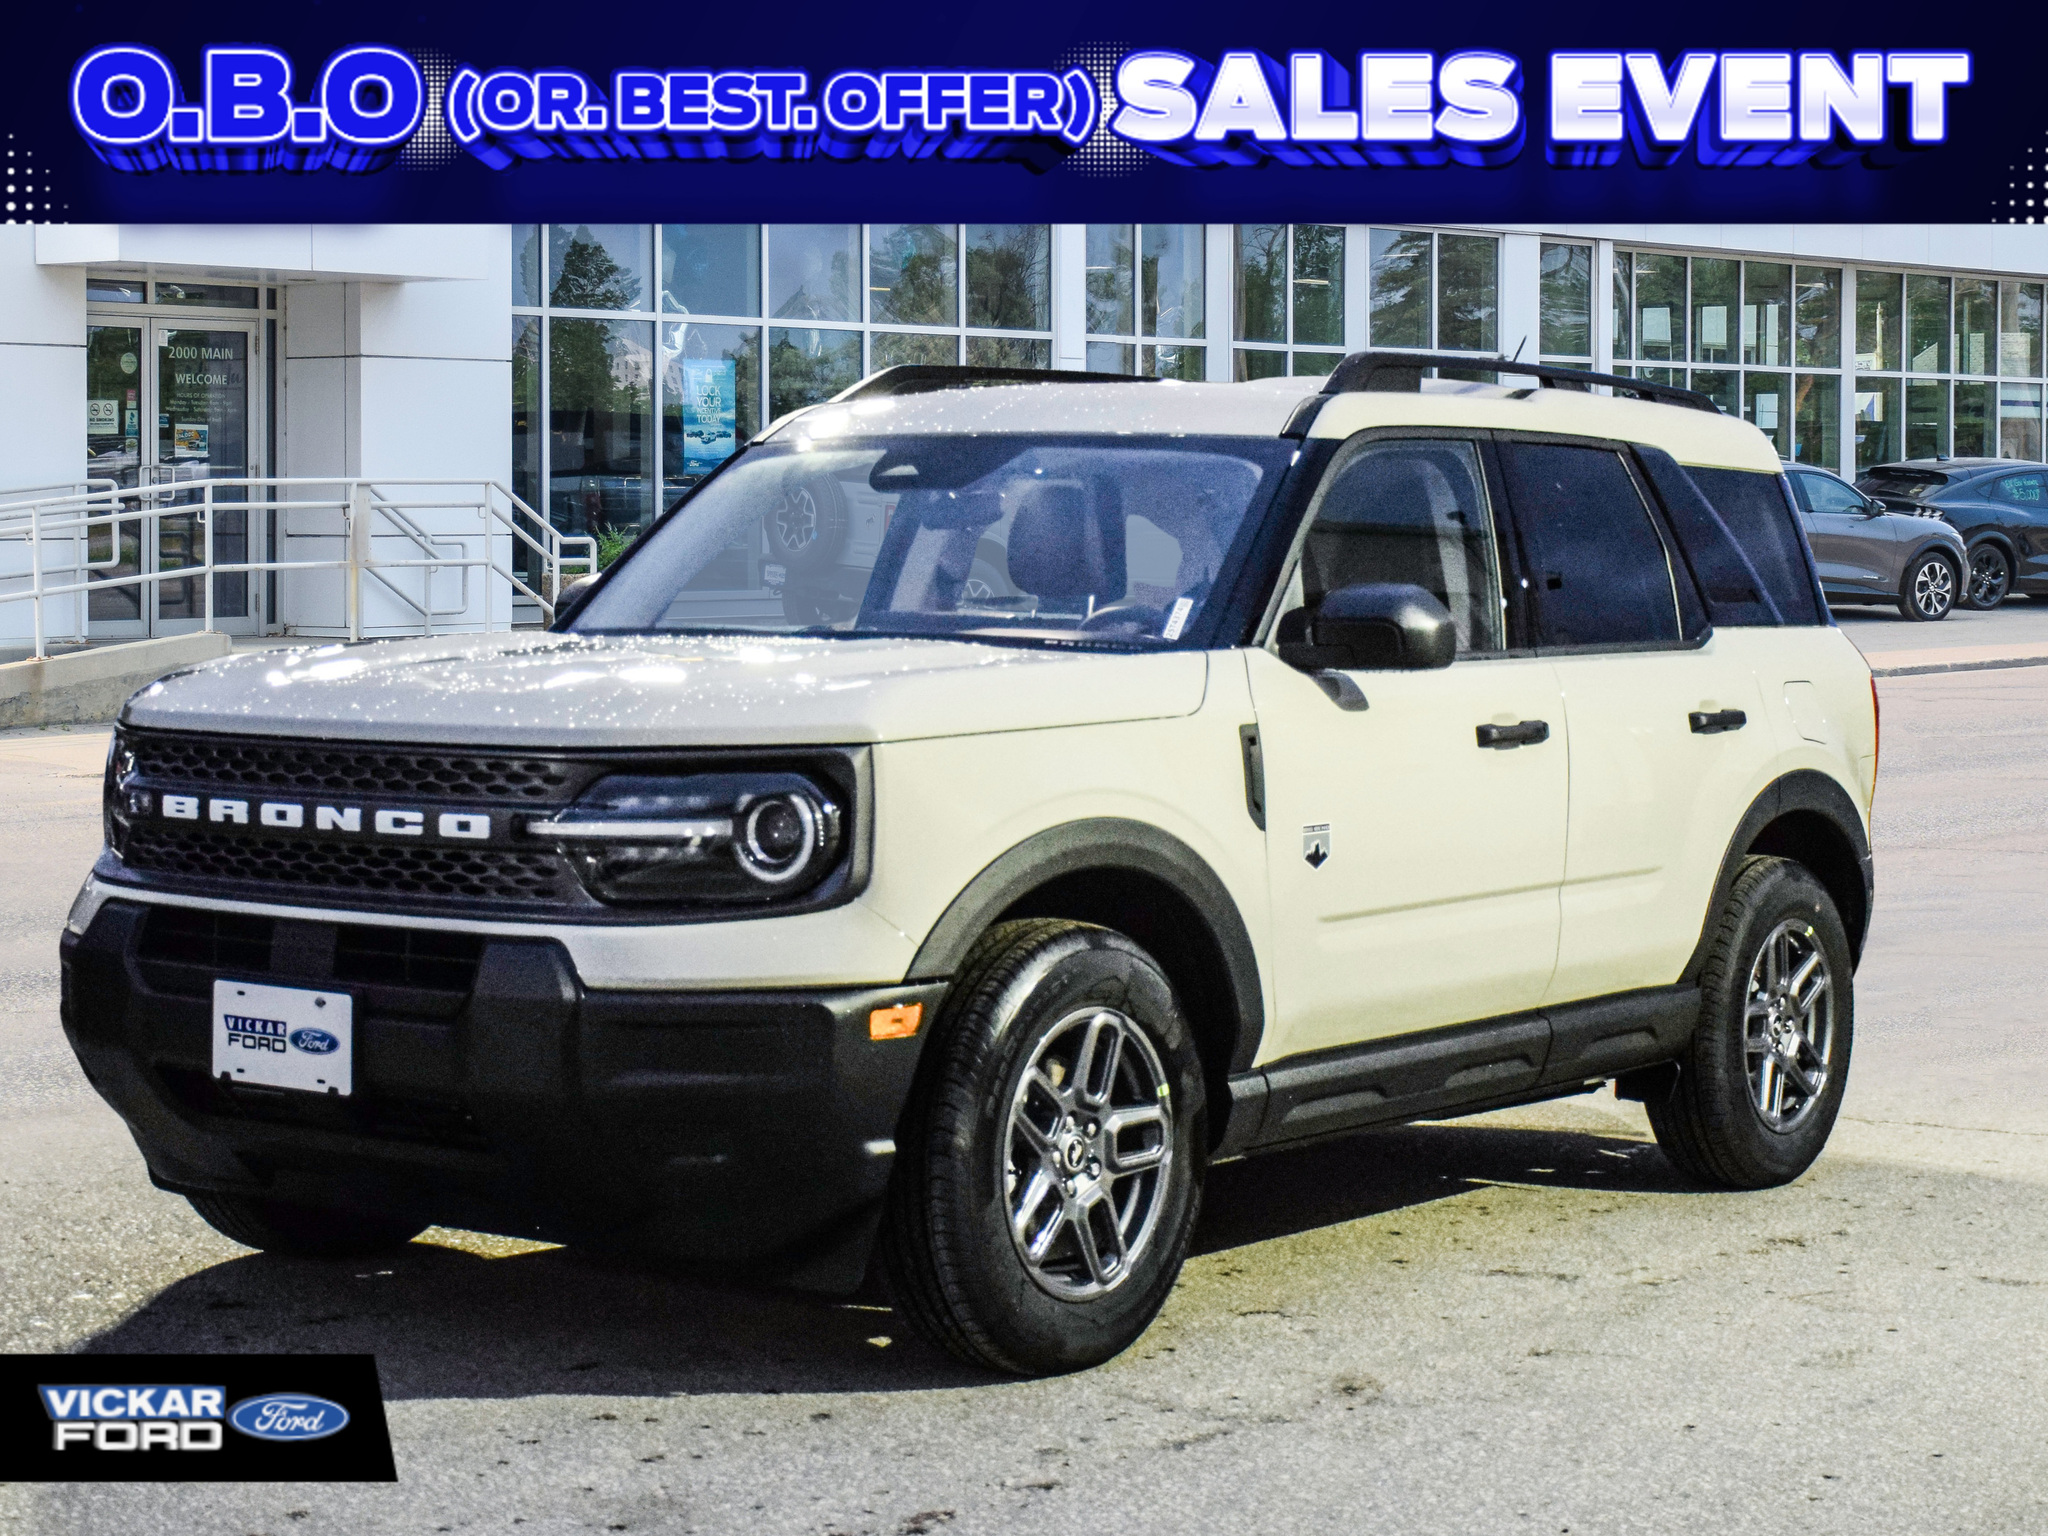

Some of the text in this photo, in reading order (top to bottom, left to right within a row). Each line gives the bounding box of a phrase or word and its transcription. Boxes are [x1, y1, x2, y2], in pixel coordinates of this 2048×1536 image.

[168, 346, 233, 360] 2000 MAIN
[175, 373, 228, 385] WELCOME
[697, 385, 721, 396] LOCK
[697, 397, 721, 407] YOUR
[697, 414, 721, 424] TODAY
[162, 794, 490, 839] BRONCO
[226, 1016, 287, 1036] VICKAR
[228, 1032, 287, 1054] FORD
[298, 1030, 330, 1051] Ford
